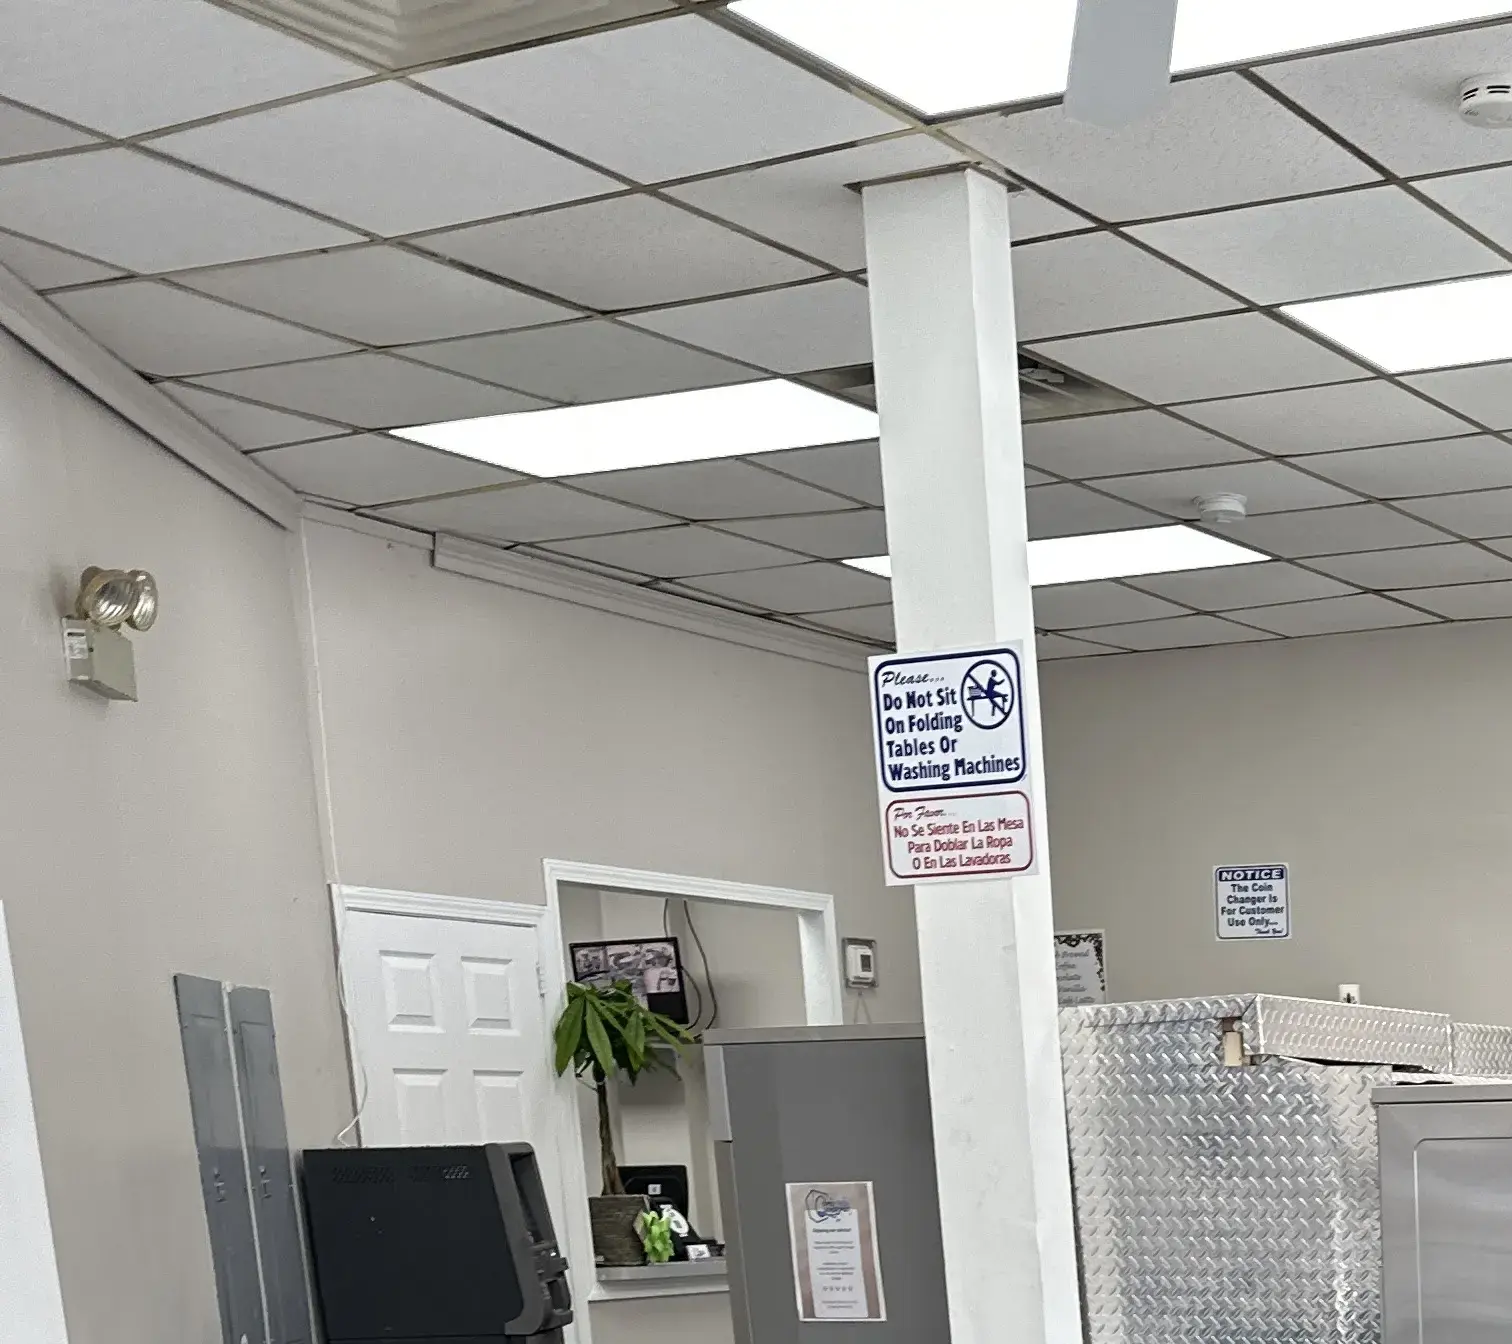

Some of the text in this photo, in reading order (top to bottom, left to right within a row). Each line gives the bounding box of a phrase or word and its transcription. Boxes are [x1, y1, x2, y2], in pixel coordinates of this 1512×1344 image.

[884, 687, 957, 711] Do Not Sit
[885, 712, 963, 734] On Folding
[886, 736, 958, 758] Tables Or
[888, 754, 1020, 781] Washing Machines
[894, 825, 908, 838] No
[911, 824, 925, 837] Se
[927, 822, 959, 835] Siente
[962, 821, 975, 833] En
[978, 819, 995, 831] Las
[907, 836, 1012, 853] Para Doblar La Ropa
[913, 852, 1011, 870] O En Las Lavadoras
[1222, 870, 1281, 880] NOTICE
[1231, 883, 1273, 892] The Coin
[1227, 894, 1278, 905] Changer Is
[1221, 906, 1284, 915] For Customer
[1228, 918, 1246, 926] Use
